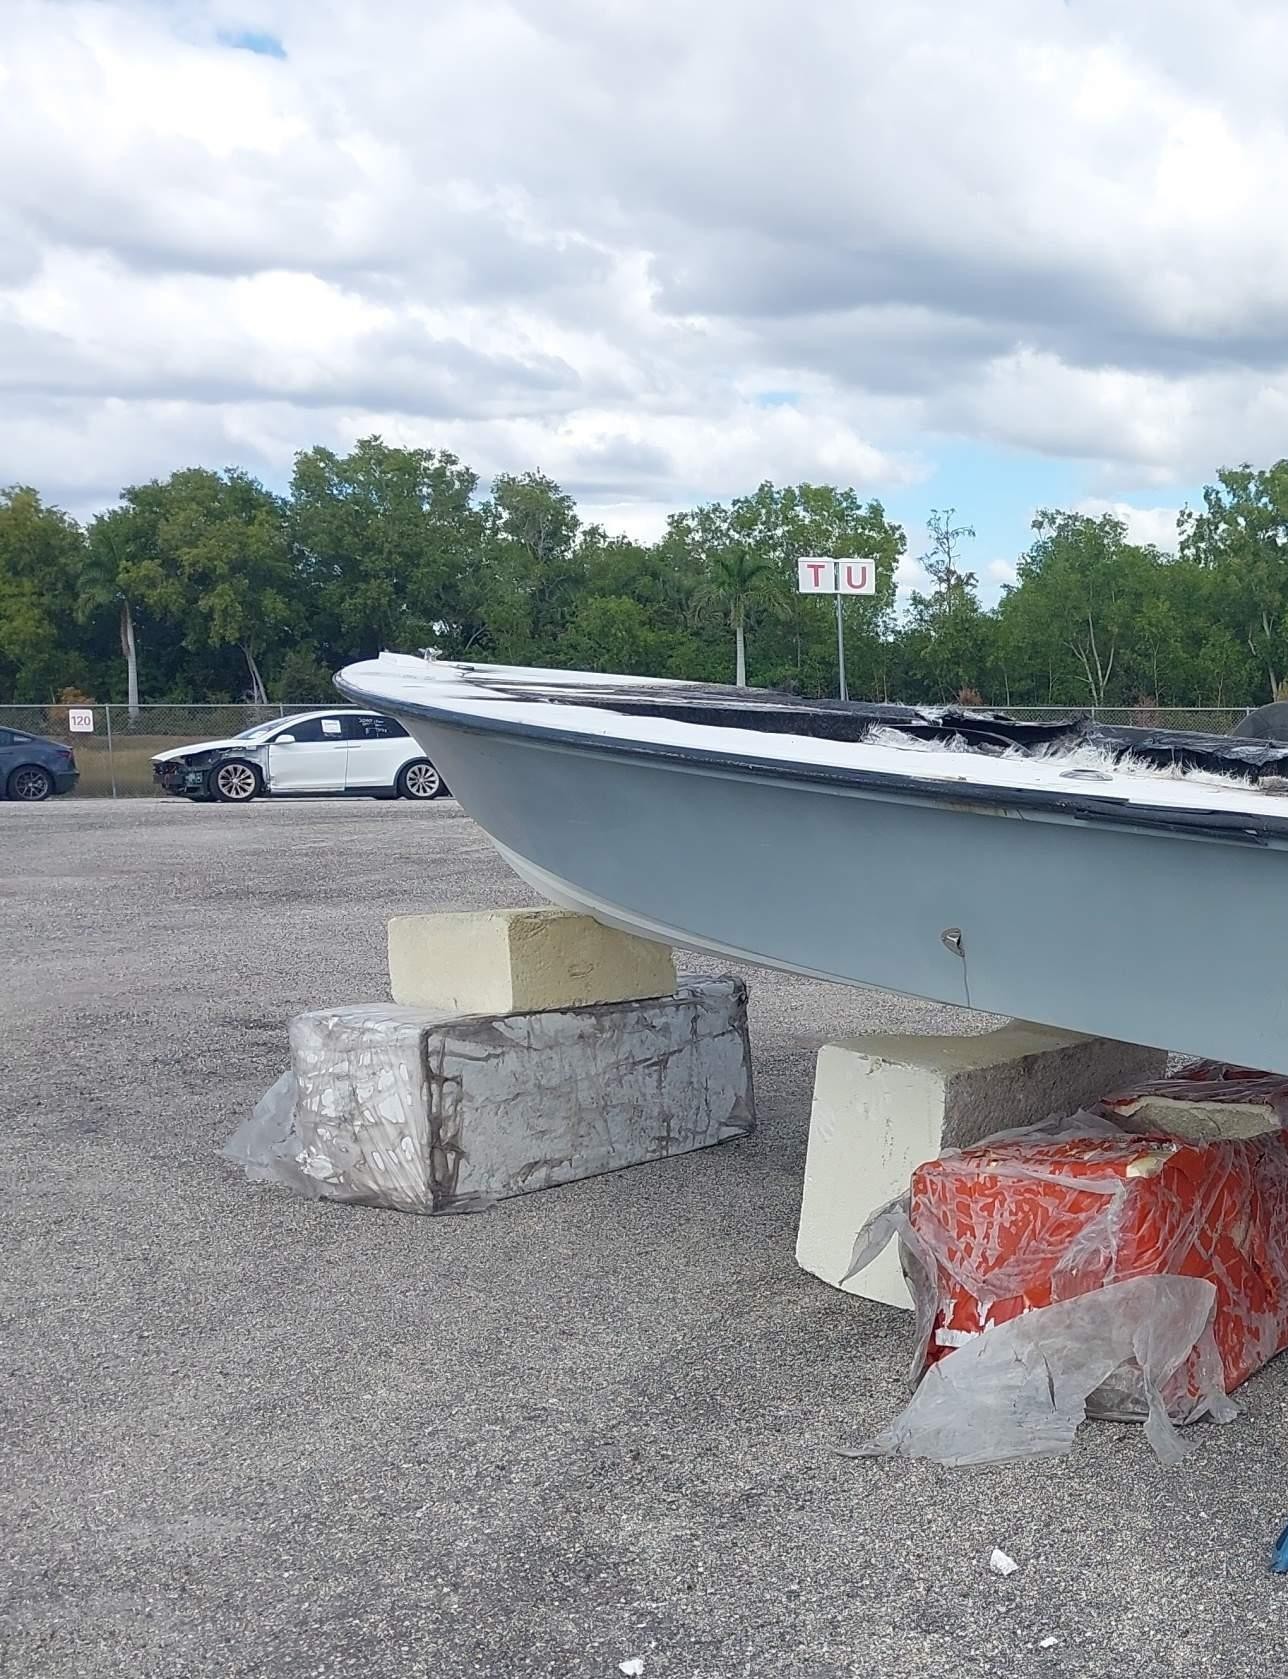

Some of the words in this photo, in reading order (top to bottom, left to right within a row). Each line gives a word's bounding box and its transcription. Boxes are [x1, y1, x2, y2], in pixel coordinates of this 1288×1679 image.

[806, 564, 825, 587] T
[846, 566, 867, 589] U
[71, 716, 91, 726] 120
